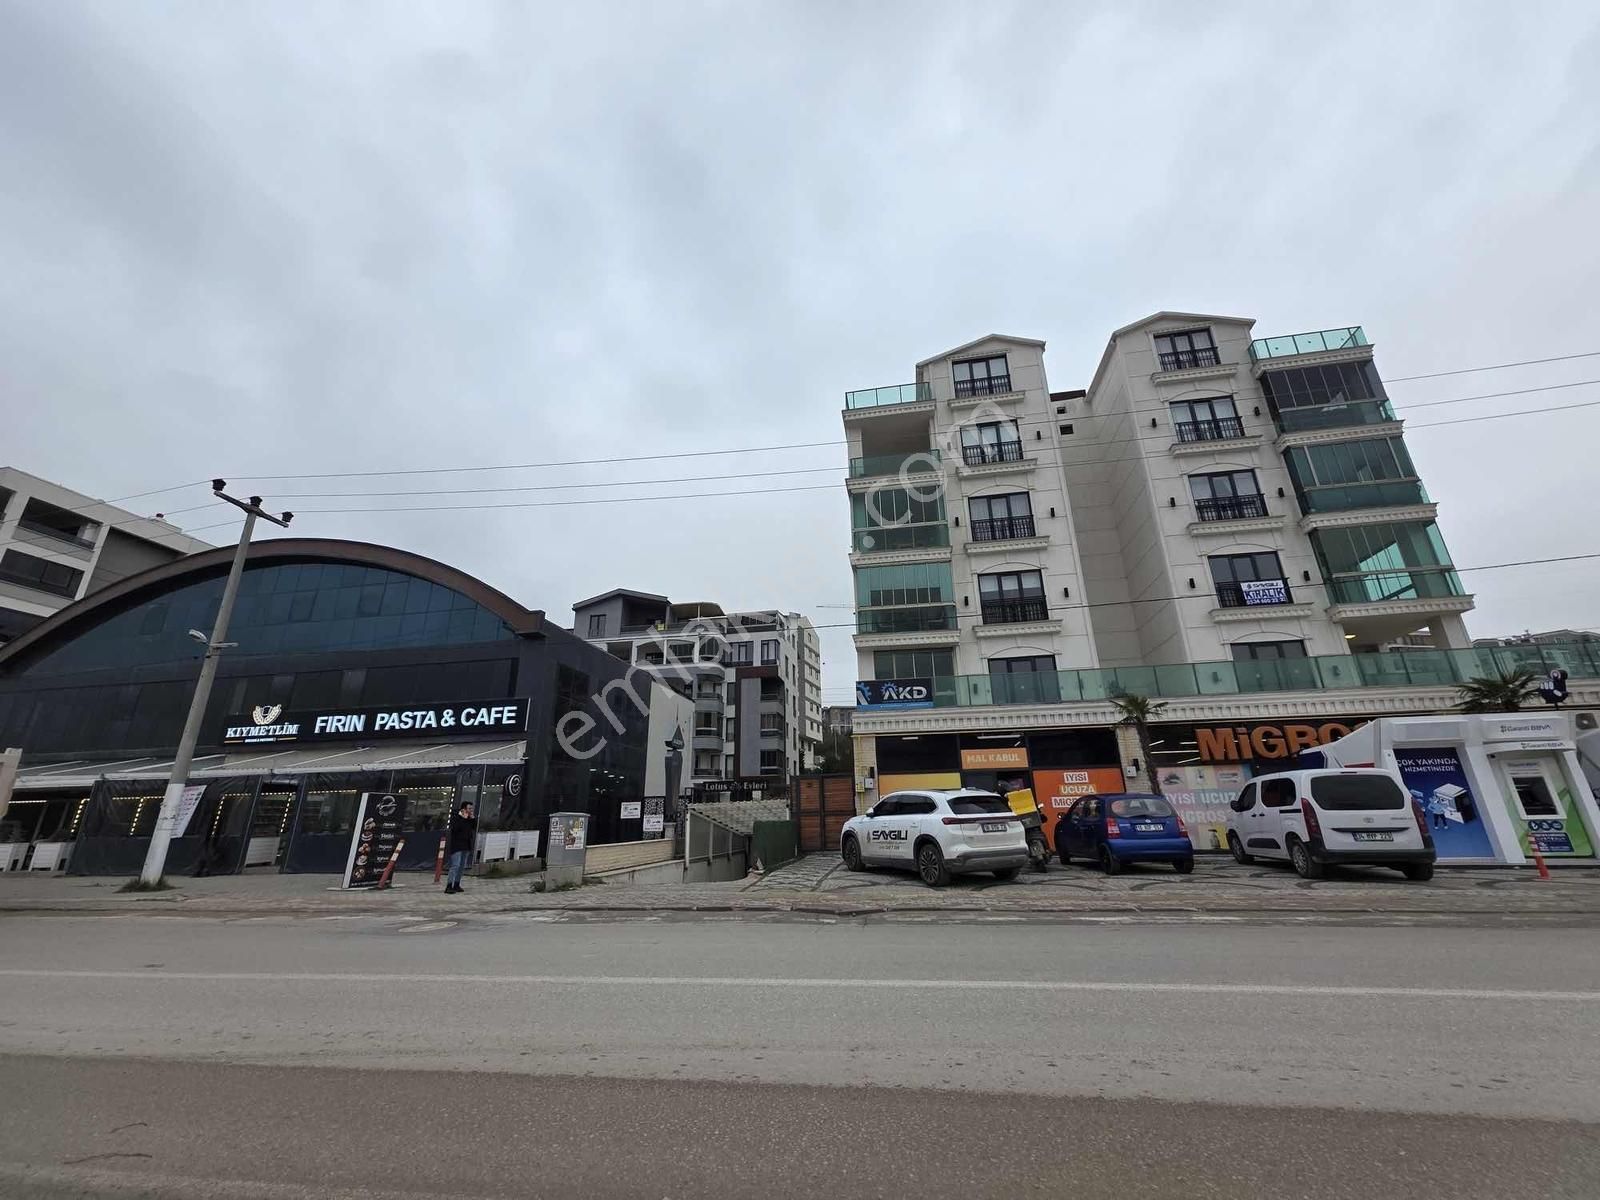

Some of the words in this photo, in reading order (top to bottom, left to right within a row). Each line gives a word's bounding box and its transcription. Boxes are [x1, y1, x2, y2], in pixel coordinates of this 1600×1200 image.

[883, 686, 927, 700] AKD
[314, 714, 366, 734] FIRIN
[374, 710, 438, 731] PASTA
[440, 708, 456, 727] &
[460, 706, 518, 726] CAFE
[226, 722, 300, 738] KIYMETLİM
[1195, 723, 1368, 761] MiGRO
[967, 754, 987, 763] MAL
[988, 753, 1021, 762] KABUL
[1418, 758, 1458, 766] YAKINDA
[705, 783, 728, 791] Lotus
[1061, 785, 1096, 794] UCUZA
[1200, 791, 1240, 804] UCUZ
[1181, 810, 1227, 824] GROS
[872, 830, 908, 841] SAYGILI
